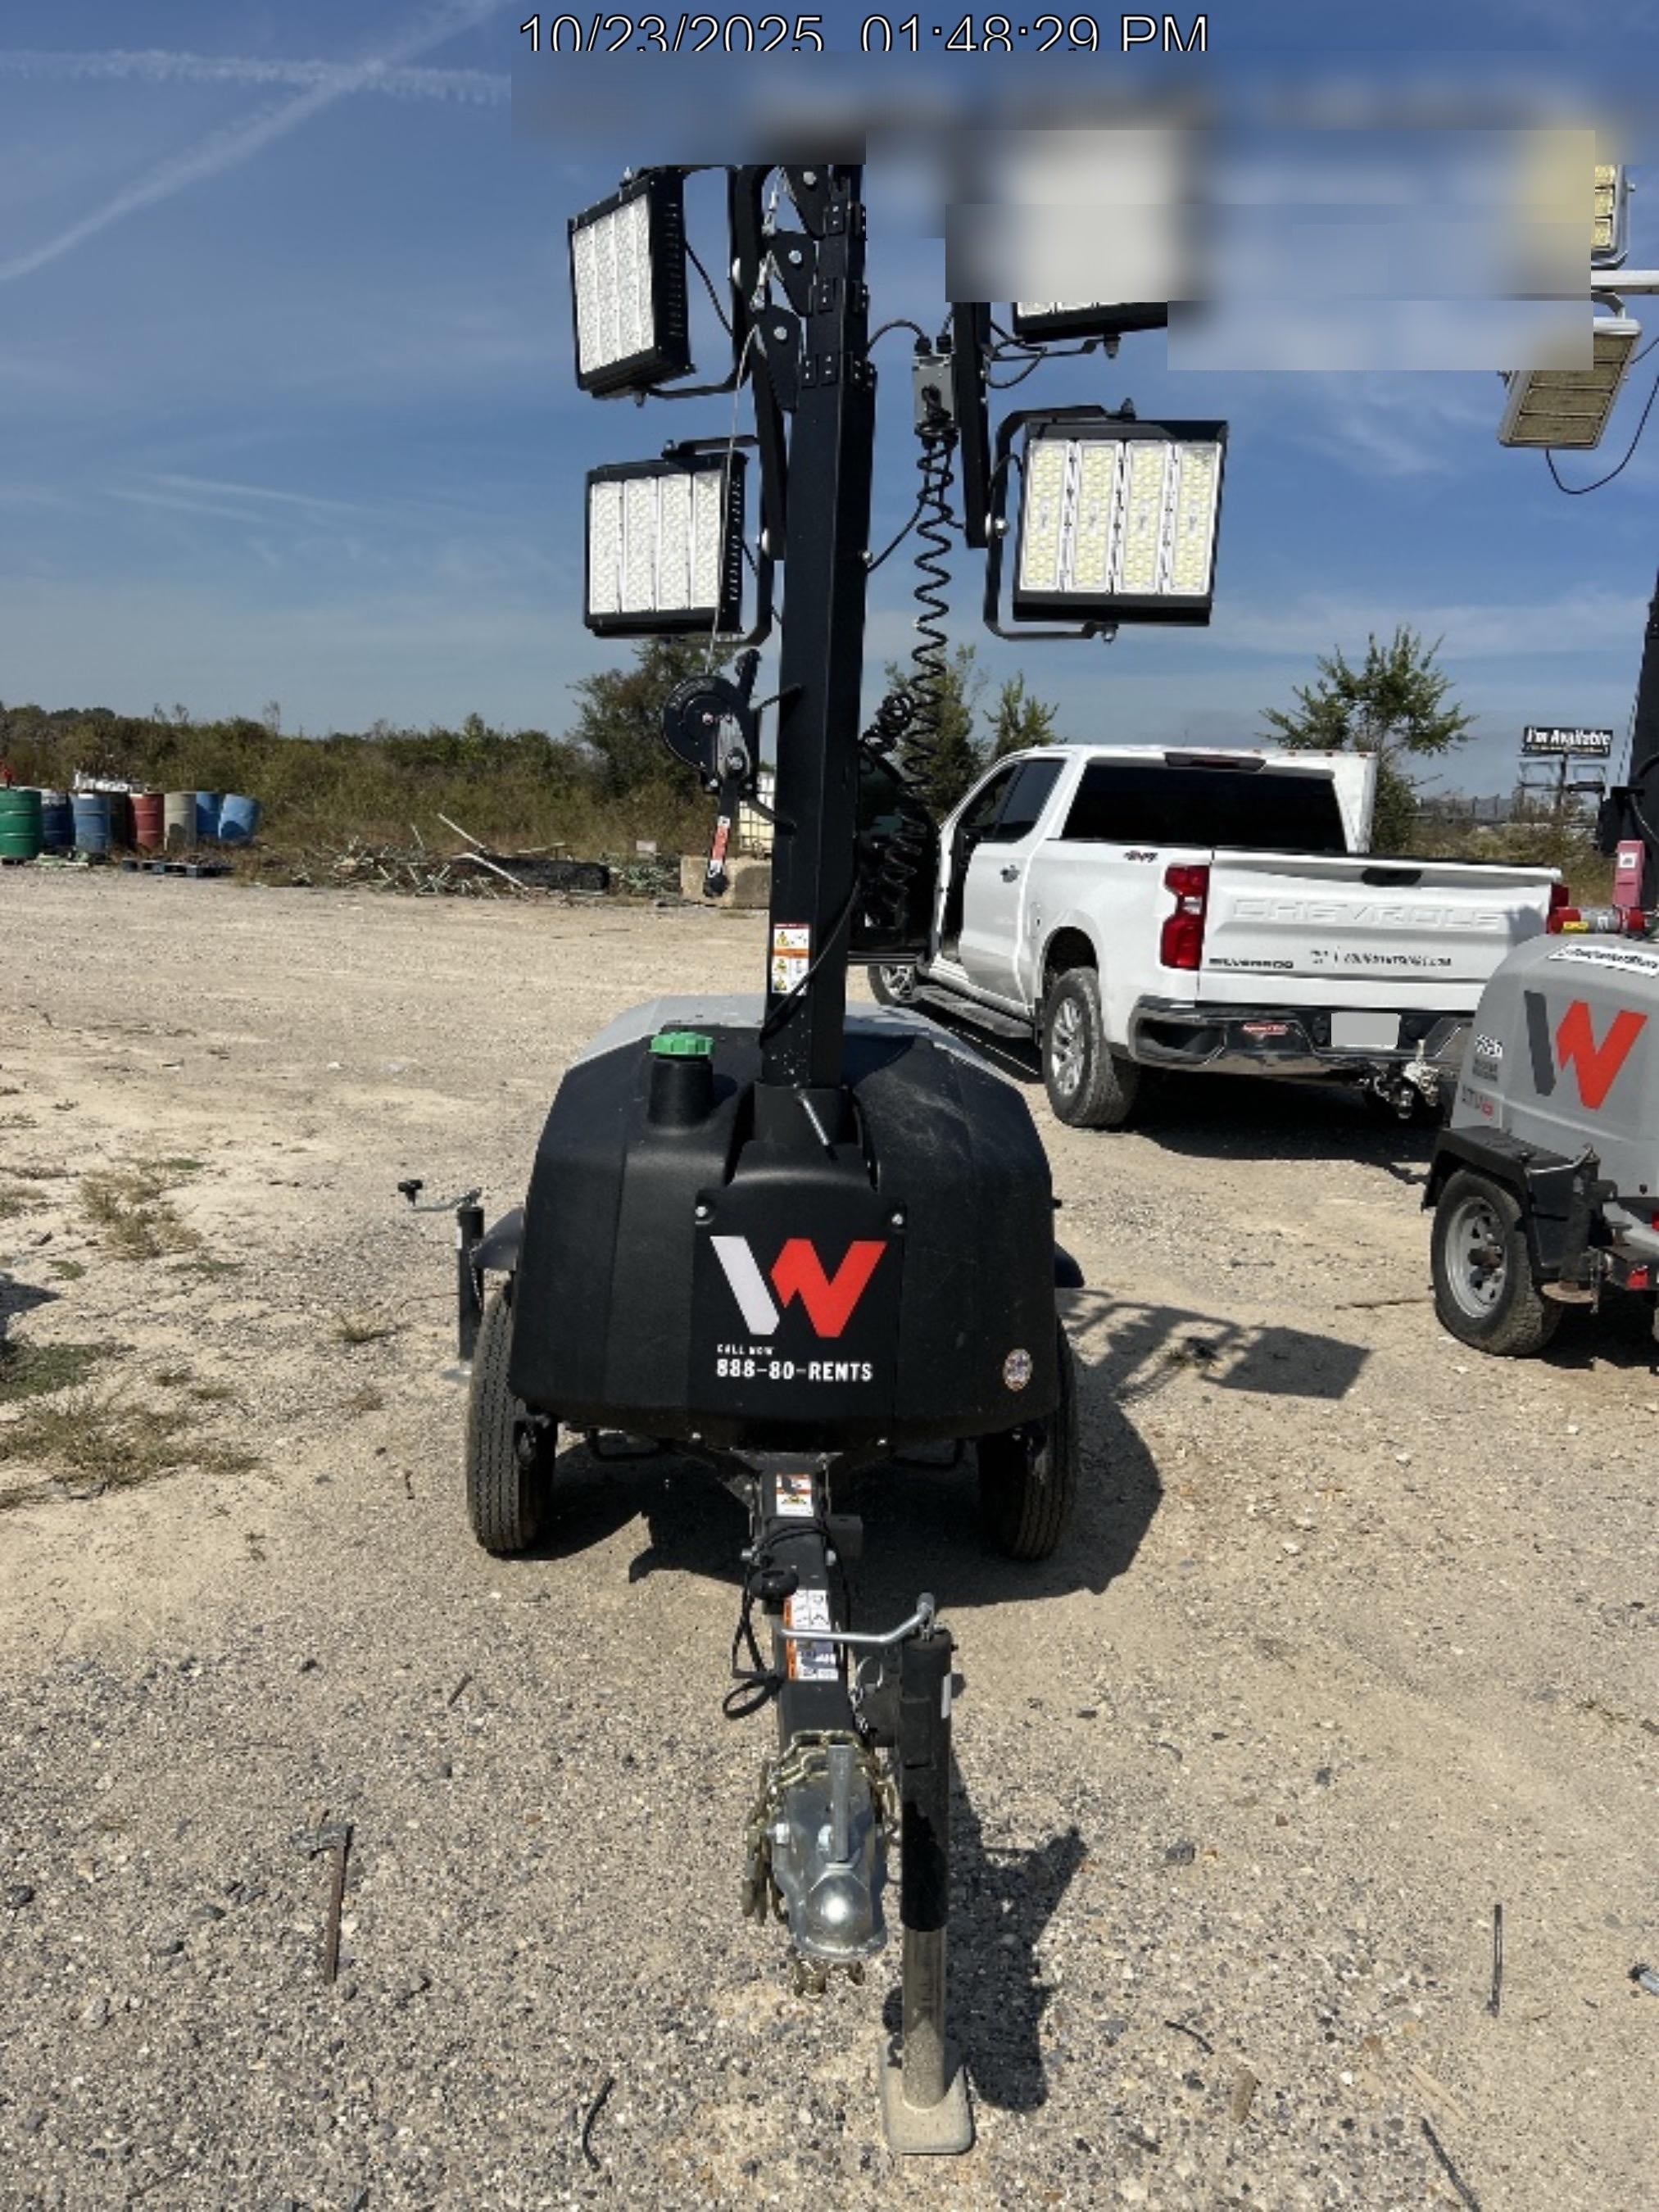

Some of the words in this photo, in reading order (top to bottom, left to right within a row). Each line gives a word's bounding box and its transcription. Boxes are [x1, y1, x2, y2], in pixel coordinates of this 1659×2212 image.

[1232, 898, 1513, 932] CHEVROLE
[716, 1344, 746, 1356] CALL
[749, 1345, 775, 1357] NOW
[716, 1358, 873, 1383] 888-80-RENTS
